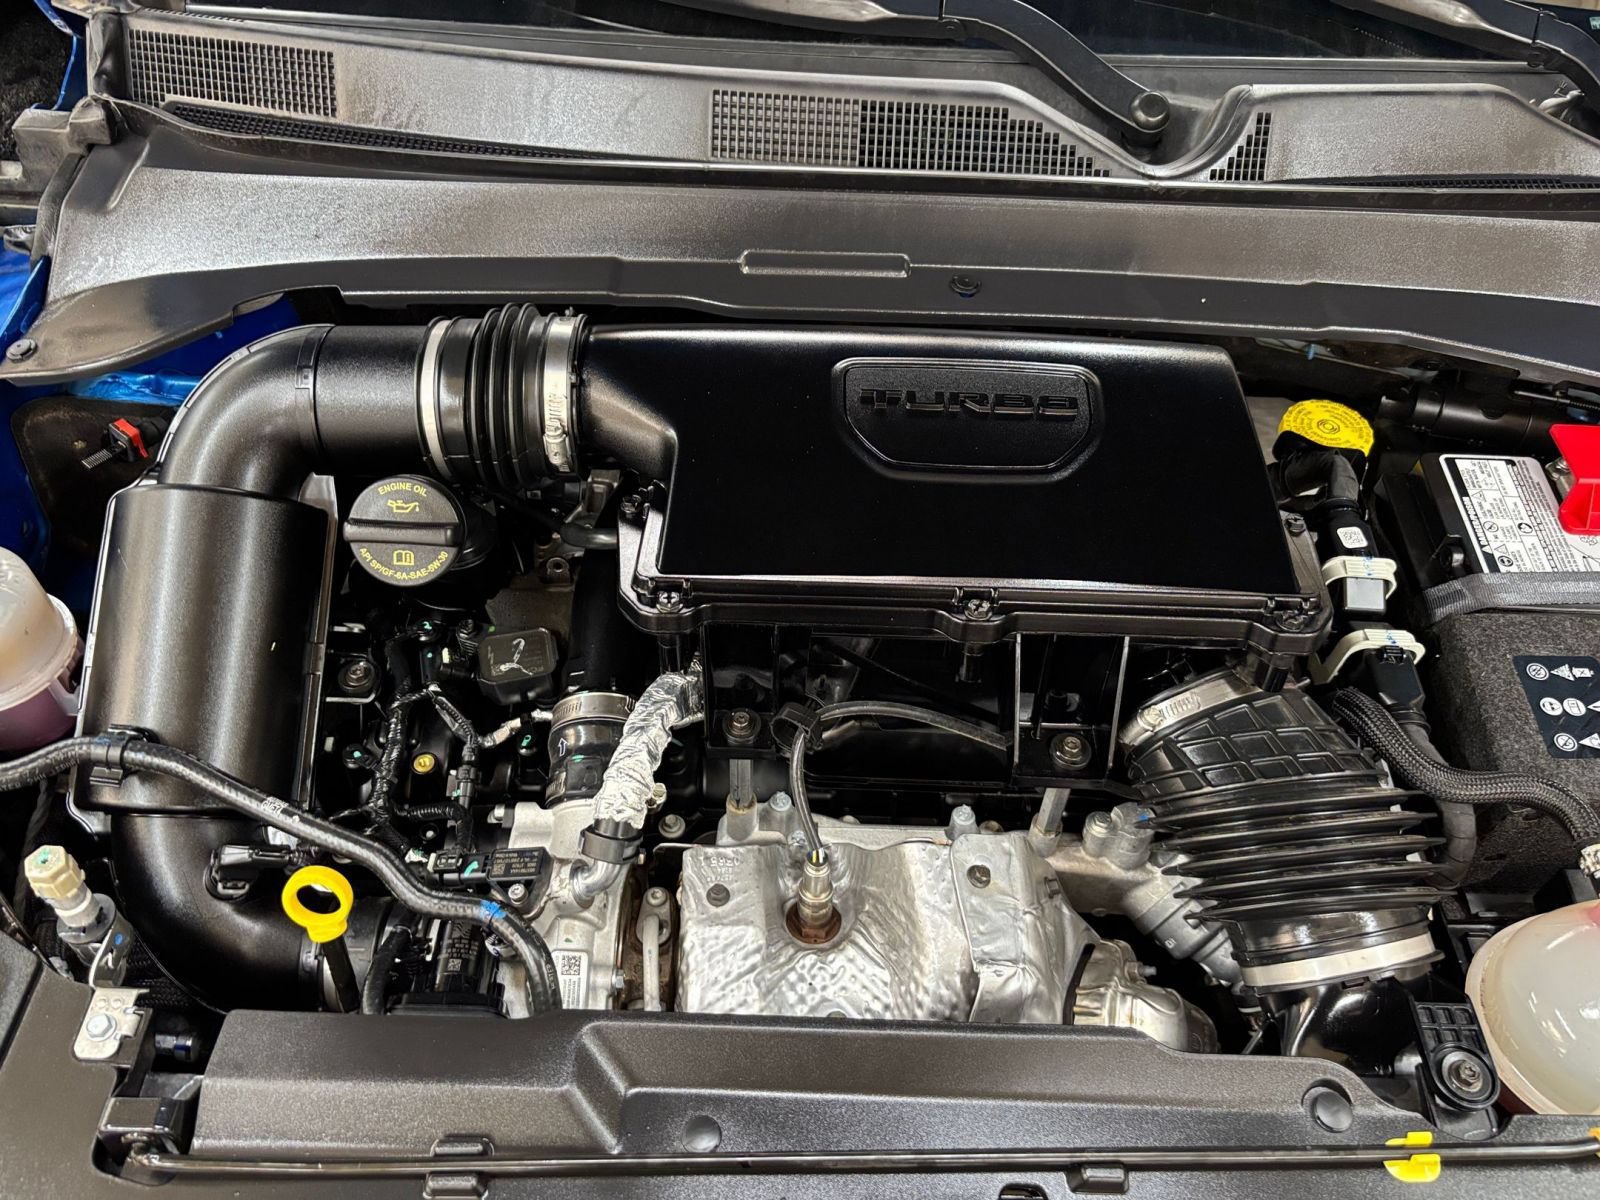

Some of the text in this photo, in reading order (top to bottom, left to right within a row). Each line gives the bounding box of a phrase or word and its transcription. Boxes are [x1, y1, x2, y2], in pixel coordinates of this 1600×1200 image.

[859, 388, 1079, 417] TURBO
[377, 482, 428, 497] ENGINE OIL
[360, 547, 374, 563] API
